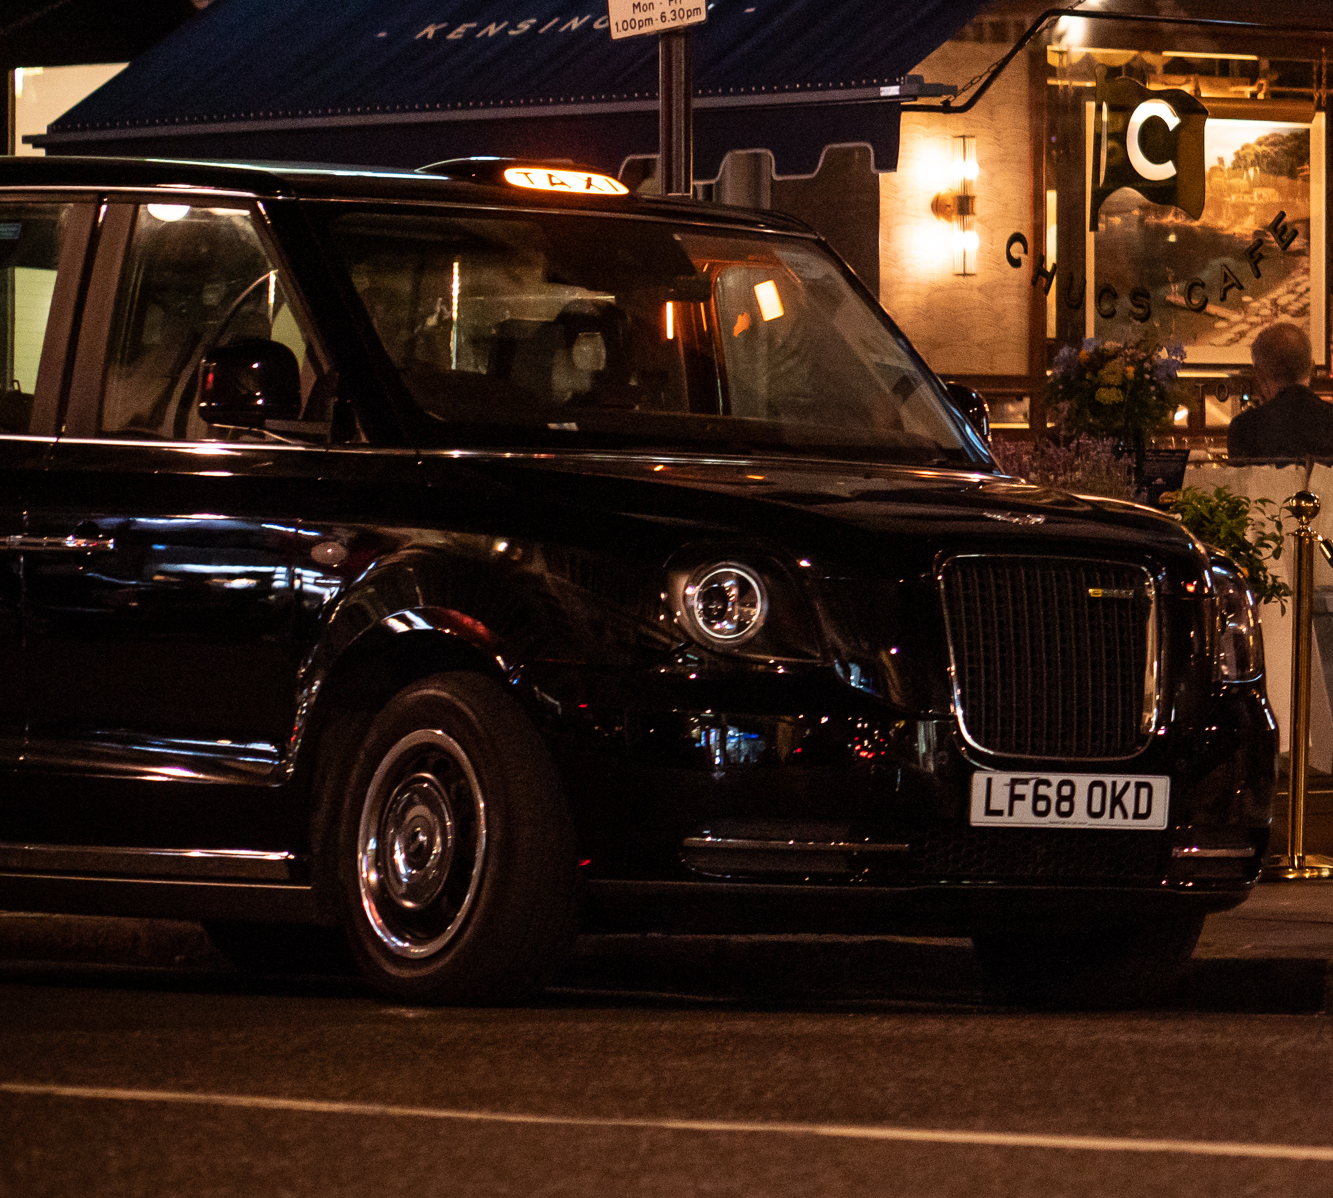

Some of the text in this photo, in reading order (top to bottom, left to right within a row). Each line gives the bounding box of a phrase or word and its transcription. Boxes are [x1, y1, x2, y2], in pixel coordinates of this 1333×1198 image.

[632, 2, 655, 15] Mon
[1125, 98, 1183, 181] C
[514, 171, 620, 192] TAXI
[1005, 210, 1299, 323] CHUCS CAFE
[984, 777, 1153, 820] LF68 OKD
